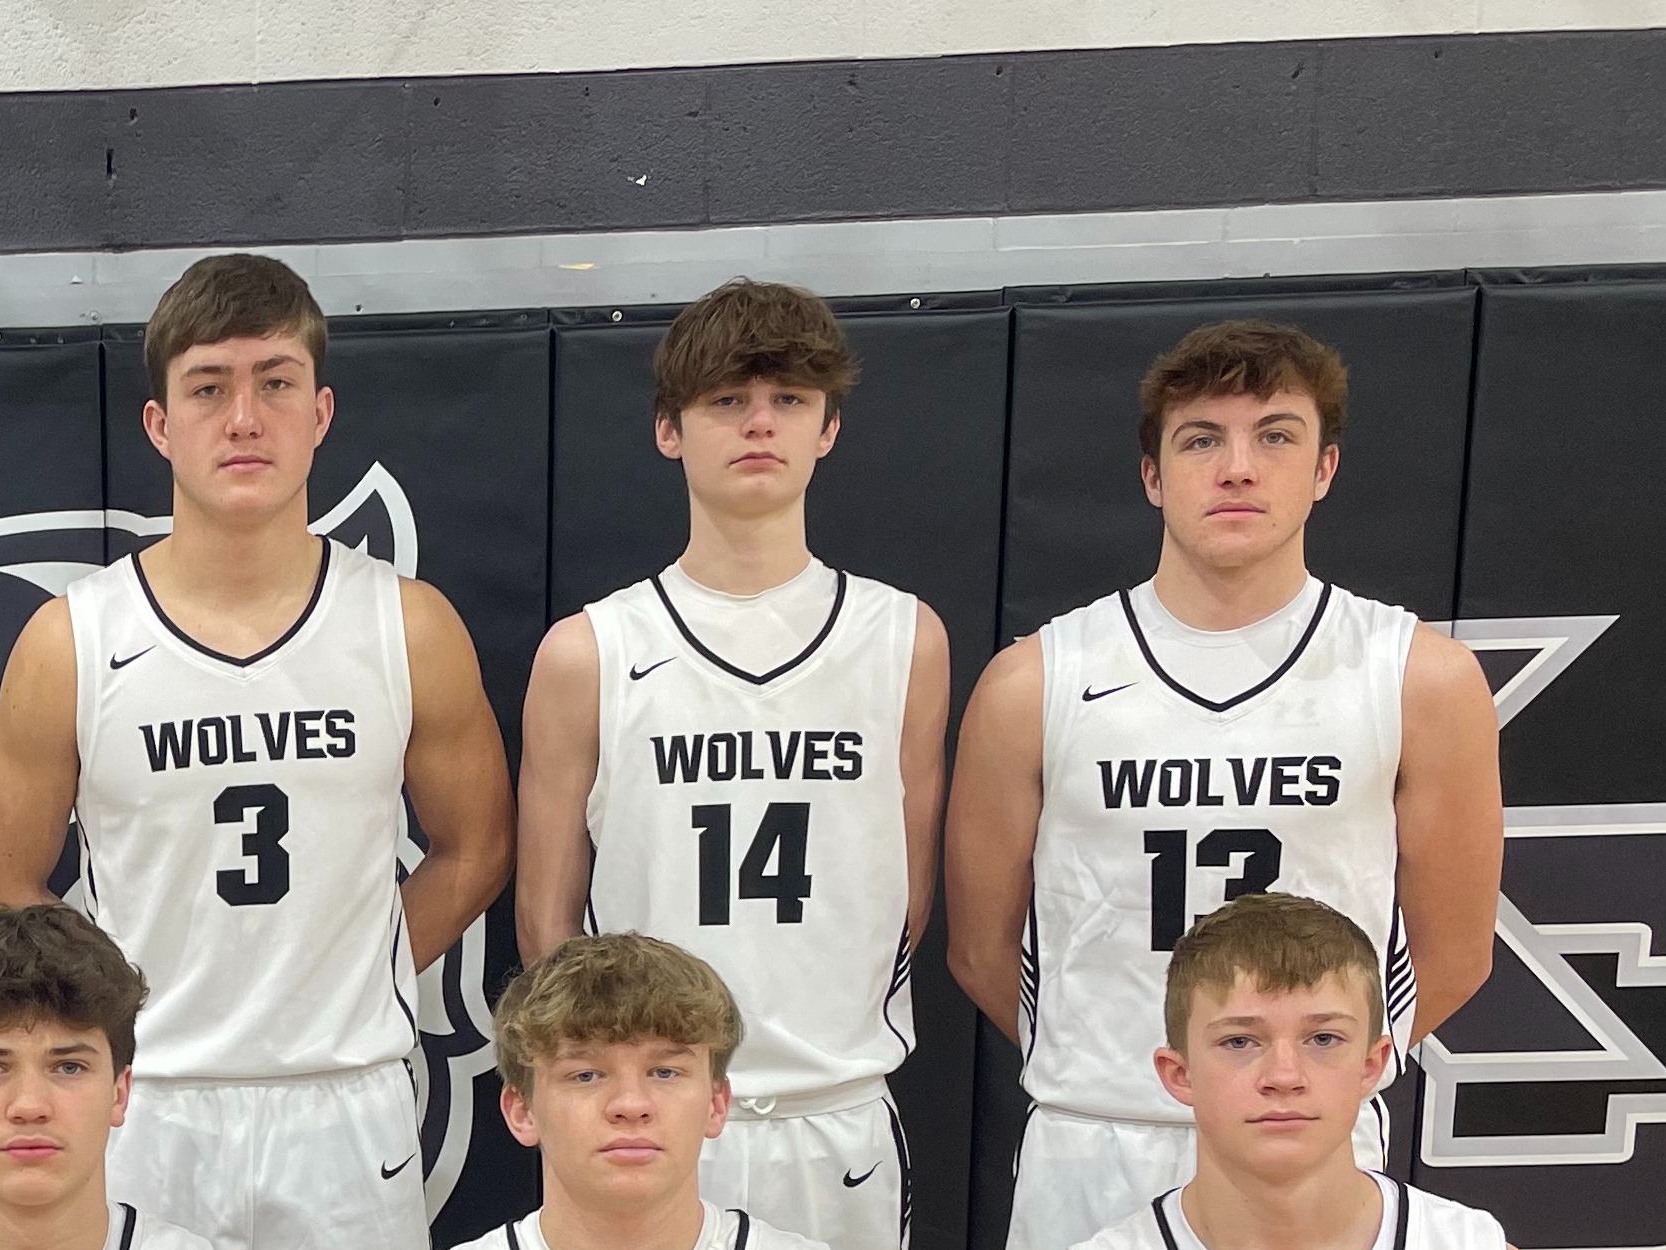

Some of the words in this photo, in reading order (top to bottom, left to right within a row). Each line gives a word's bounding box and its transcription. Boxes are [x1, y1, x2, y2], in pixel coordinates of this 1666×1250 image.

[139, 710, 355, 772] WOLVES
[650, 731, 862, 784] WOLVES
[1097, 756, 1341, 809] WOLVES
[214, 784, 289, 906] 3
[692, 803, 812, 925] 14
